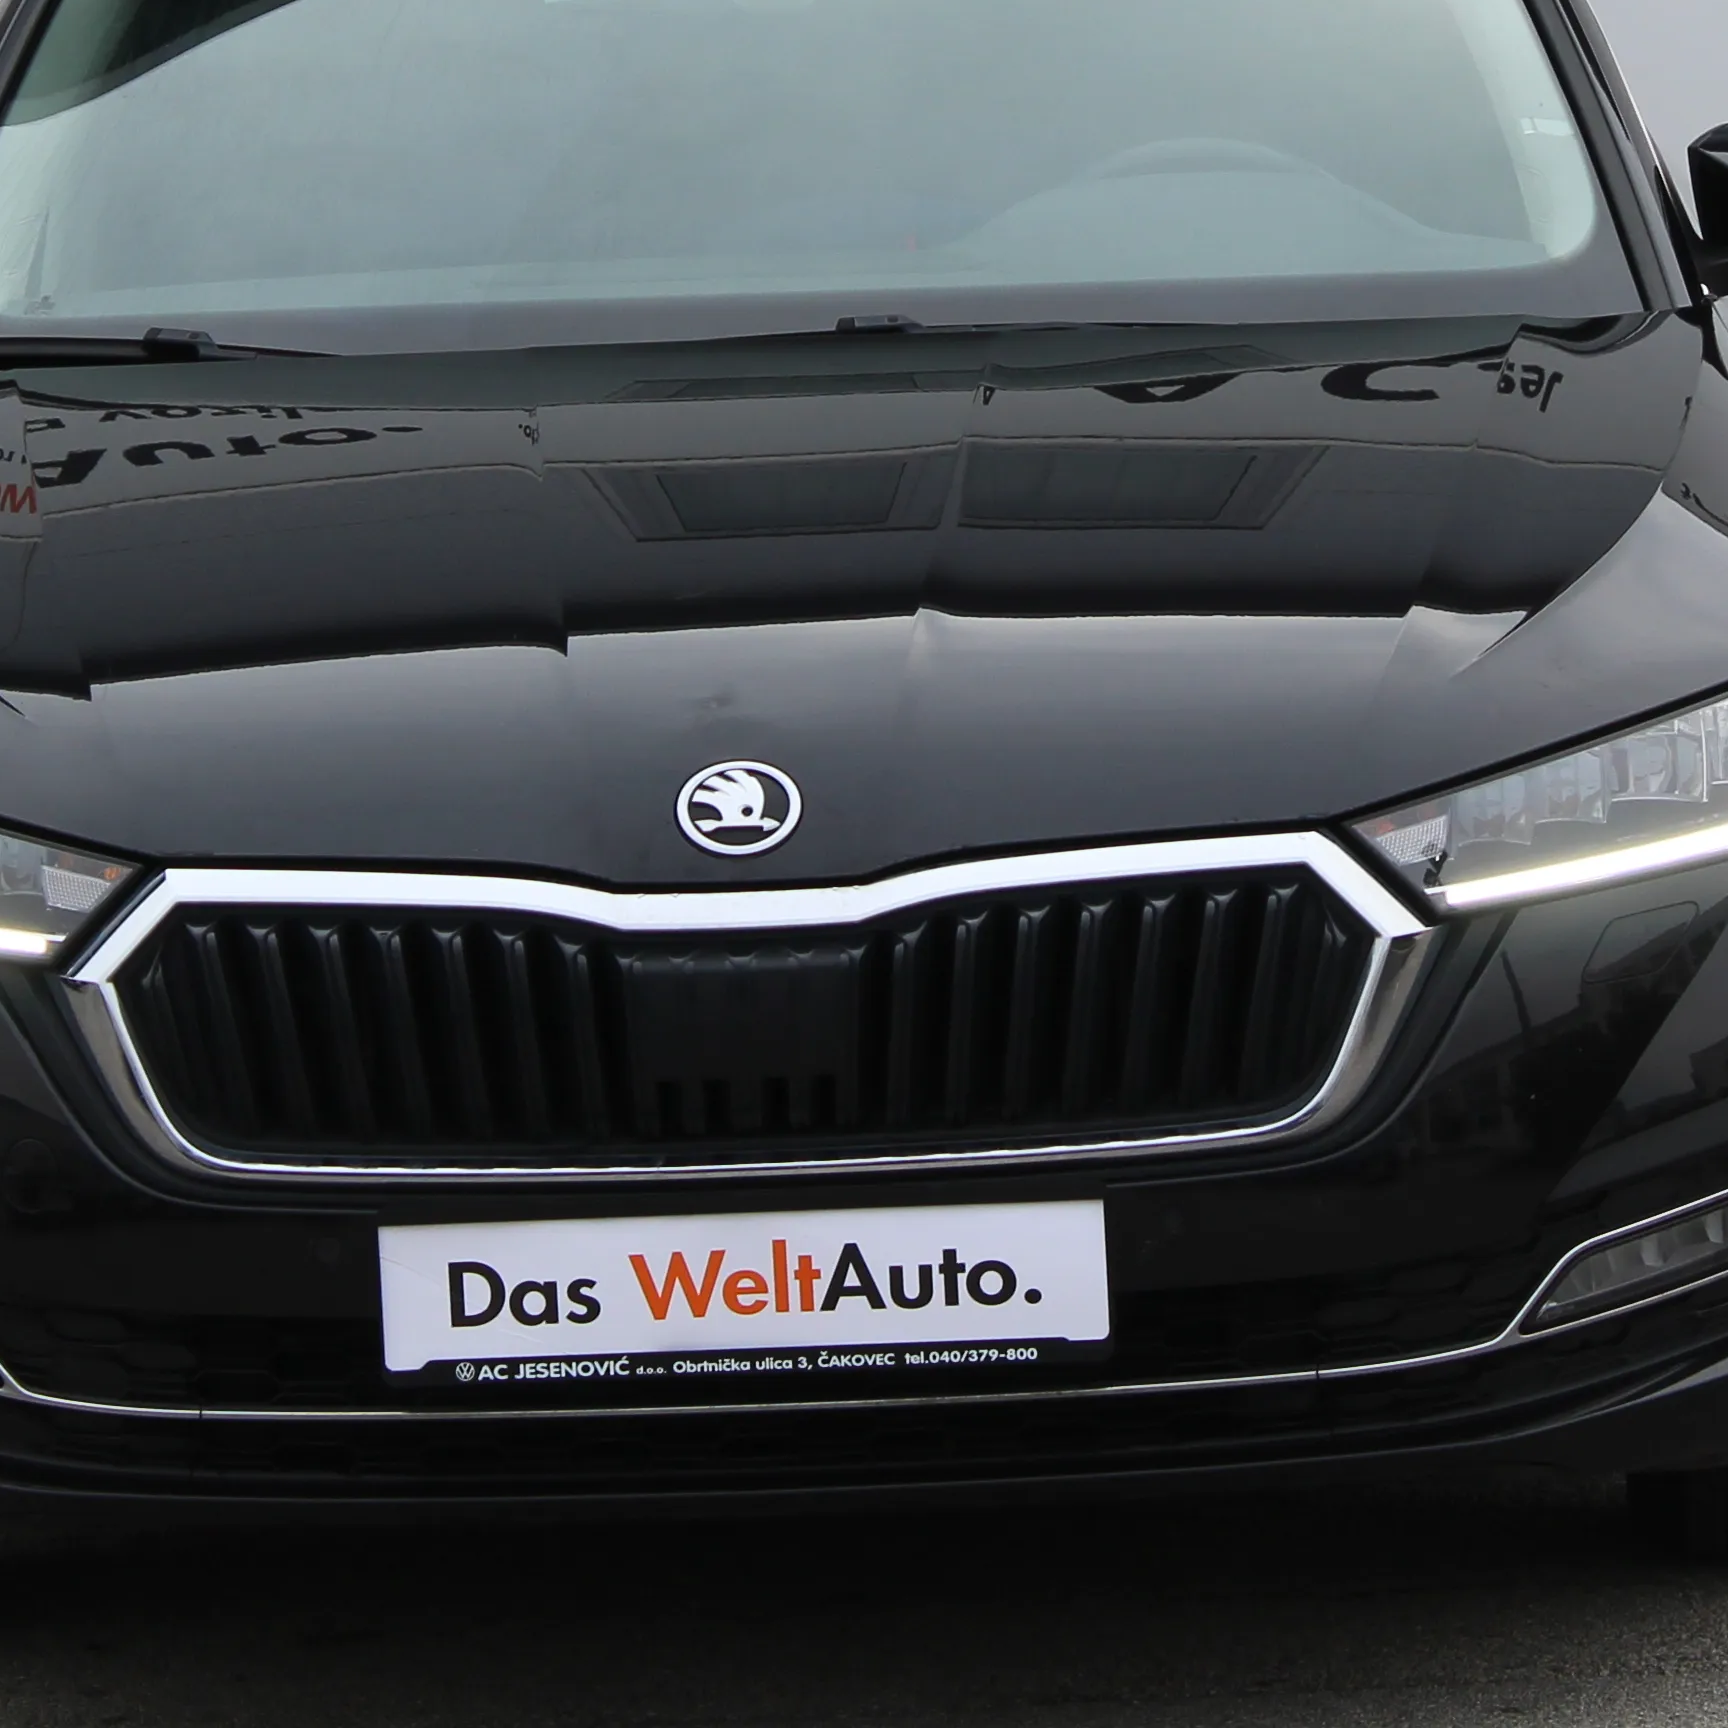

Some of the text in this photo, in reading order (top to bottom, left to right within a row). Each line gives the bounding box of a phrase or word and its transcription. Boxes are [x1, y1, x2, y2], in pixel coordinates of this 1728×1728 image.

[447, 1239, 1042, 1328] Das WeltAuto.
[477, 1363, 509, 1381] AC
[514, 1355, 630, 1380] JESENOVIĆ
[672, 1358, 751, 1374] Obrtnička
[755, 1356, 793, 1371] ulica
[797, 1356, 813, 1372] 3,
[817, 1350, 896, 1368] ČAKOVEC
[904, 1347, 1038, 1365] tel.040/379-800
